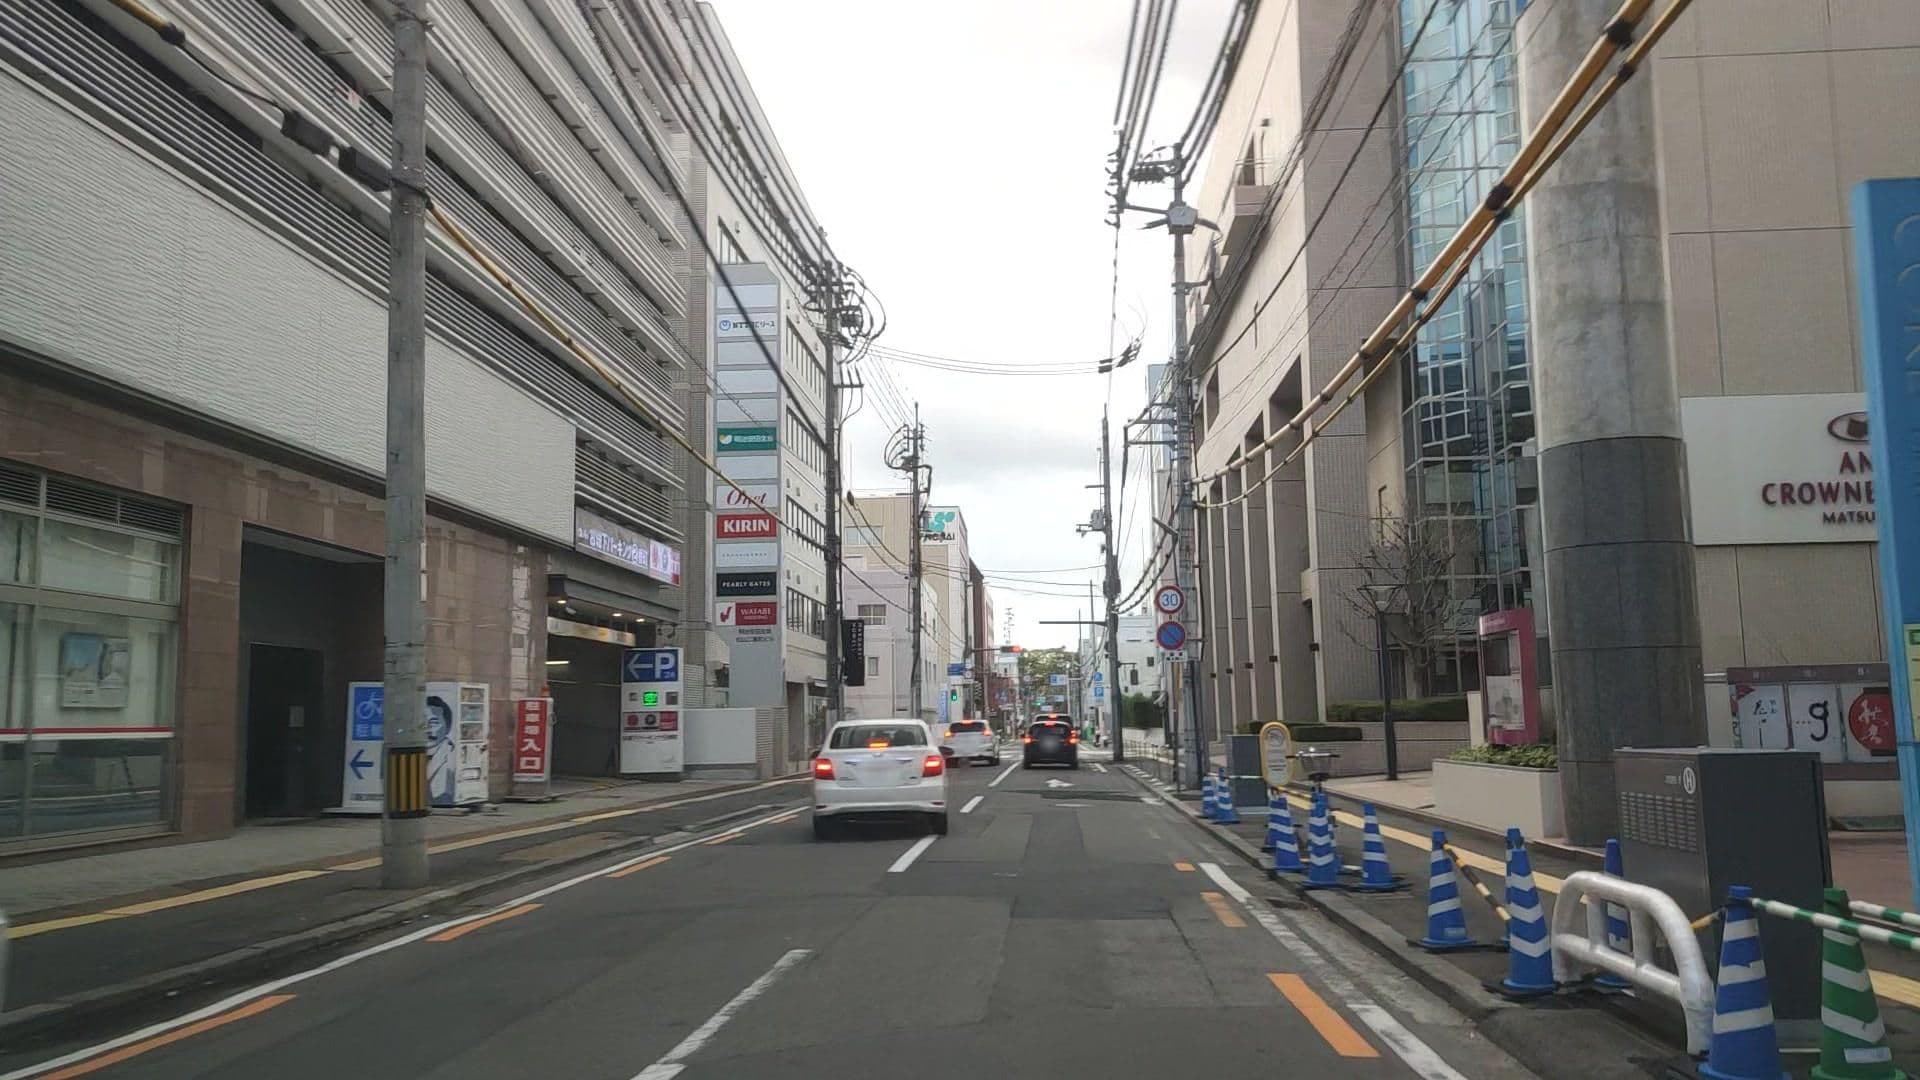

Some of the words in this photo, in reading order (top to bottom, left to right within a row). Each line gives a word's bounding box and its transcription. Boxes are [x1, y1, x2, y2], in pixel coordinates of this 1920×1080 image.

[724, 519, 769, 533] KIRIN
[1162, 594, 1179, 607] 30
[655, 652, 676, 680] P
